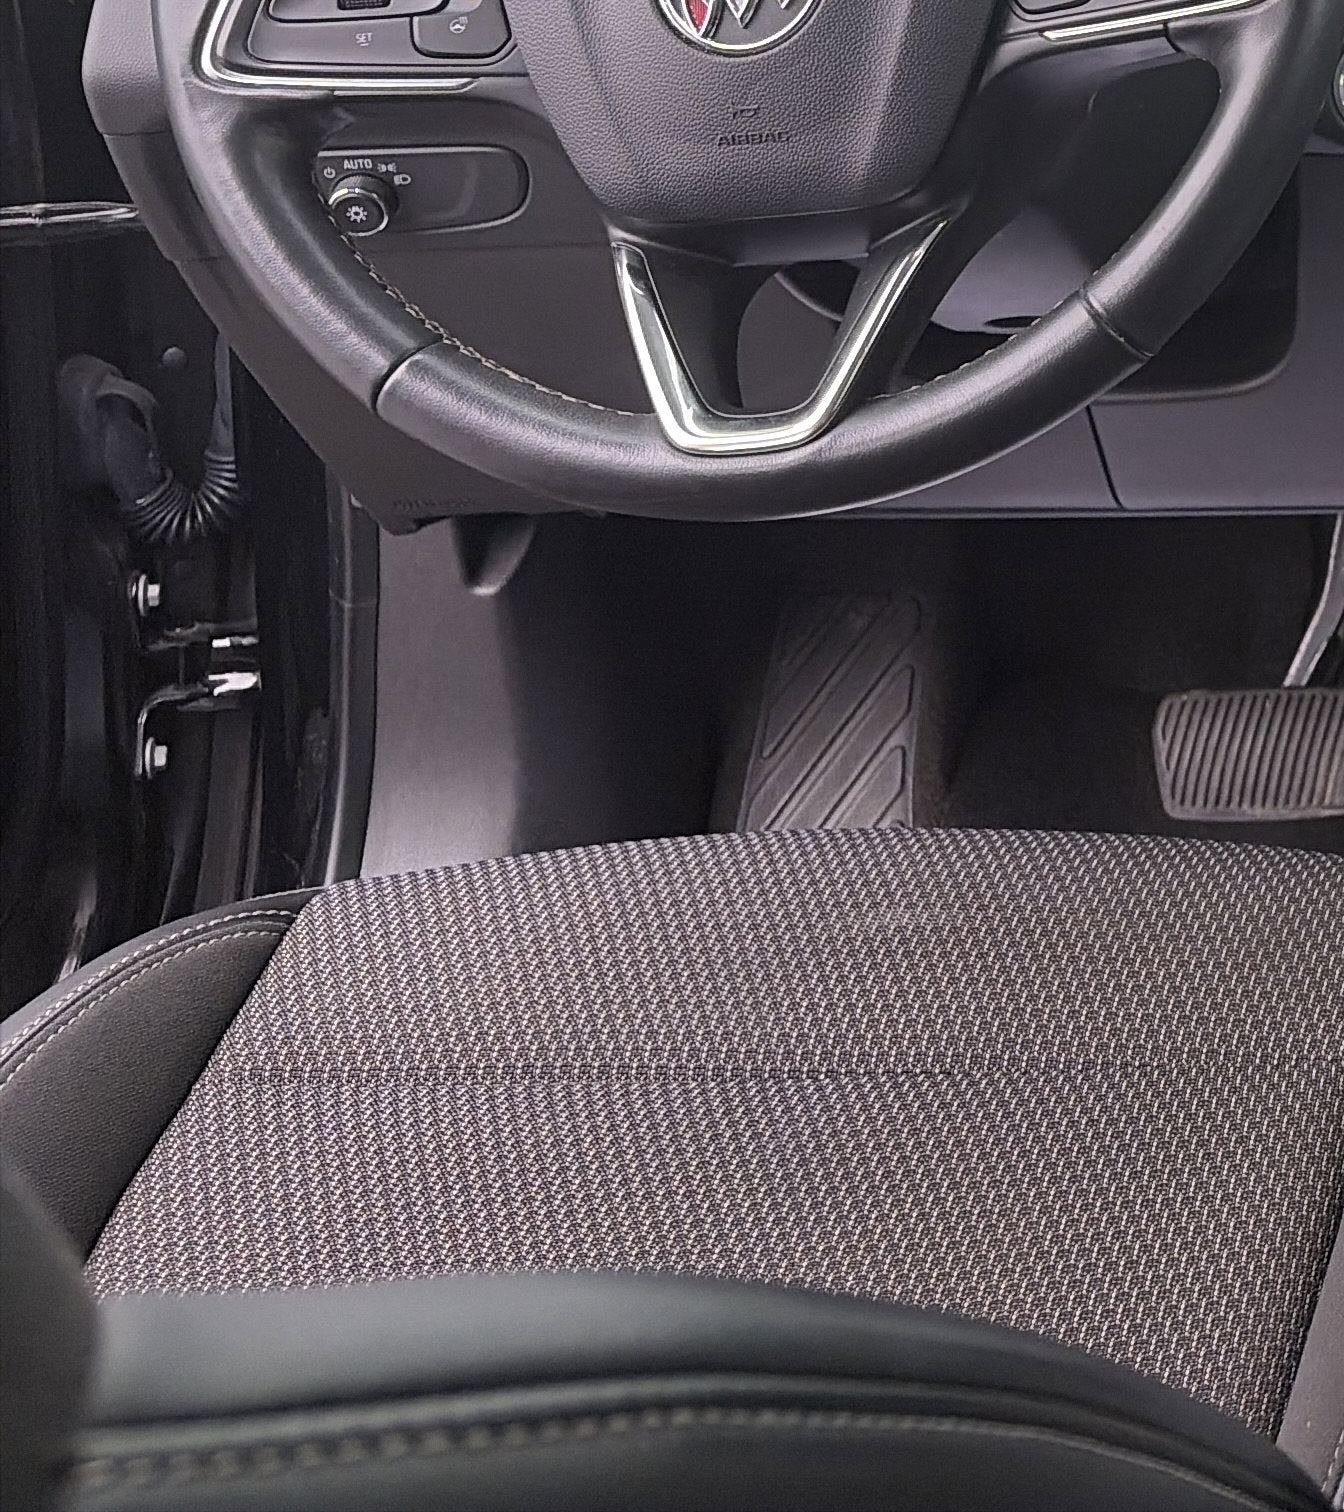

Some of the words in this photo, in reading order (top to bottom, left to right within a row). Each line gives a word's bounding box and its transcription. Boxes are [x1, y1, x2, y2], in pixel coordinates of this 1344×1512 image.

[355, 32, 373, 44] SET
[717, 132, 790, 146] AIRBAG
[343, 158, 373, 170] AUTO
